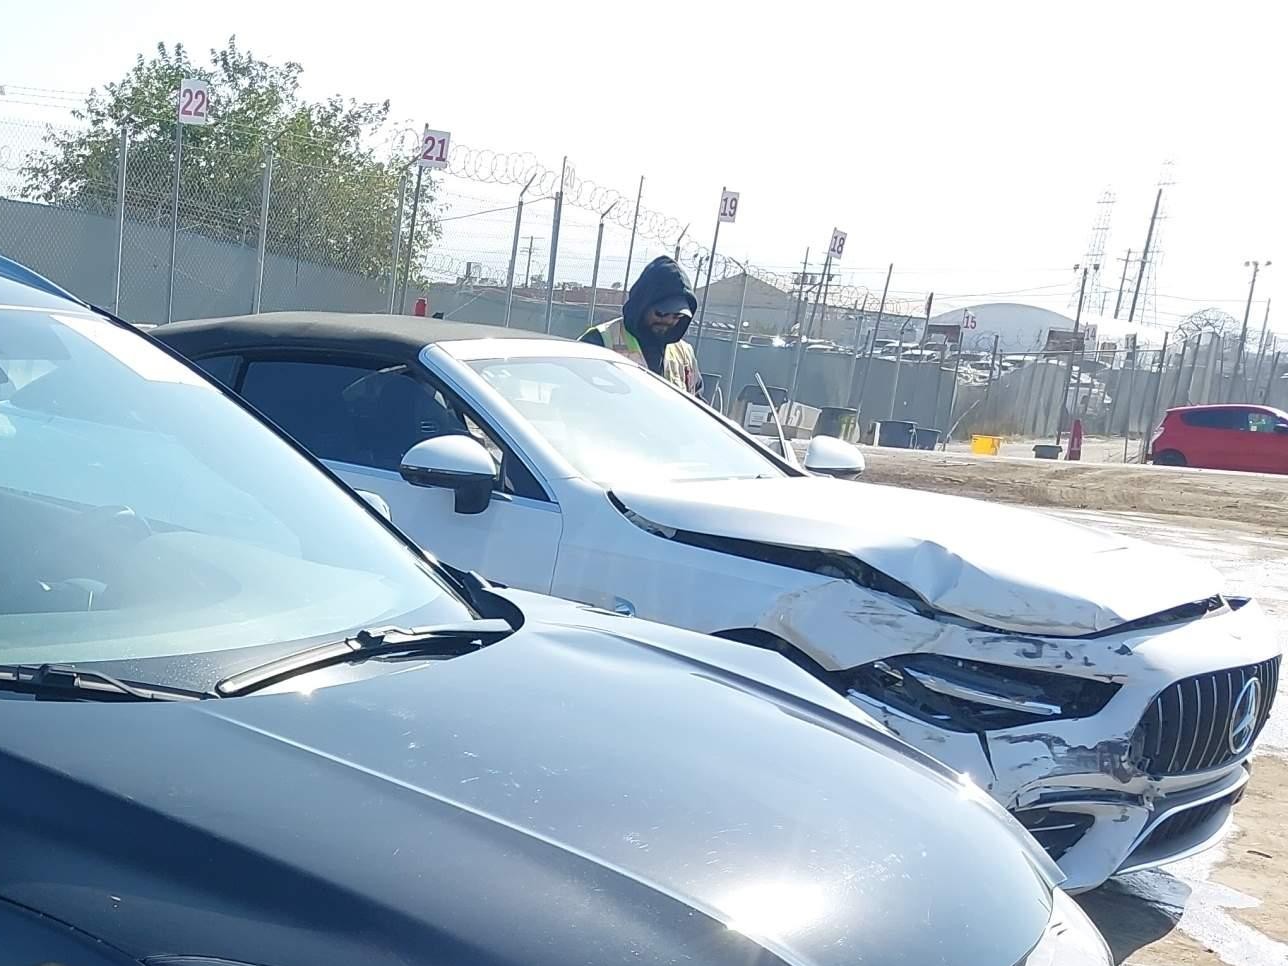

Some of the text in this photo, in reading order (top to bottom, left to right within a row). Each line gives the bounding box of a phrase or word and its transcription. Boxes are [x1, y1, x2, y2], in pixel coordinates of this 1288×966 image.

[181, 88, 206, 117] 22
[422, 136, 446, 162] 21
[564, 165, 576, 189] 20
[720, 197, 738, 218] 19
[830, 235, 845, 255] 18
[963, 315, 977, 330] 15
